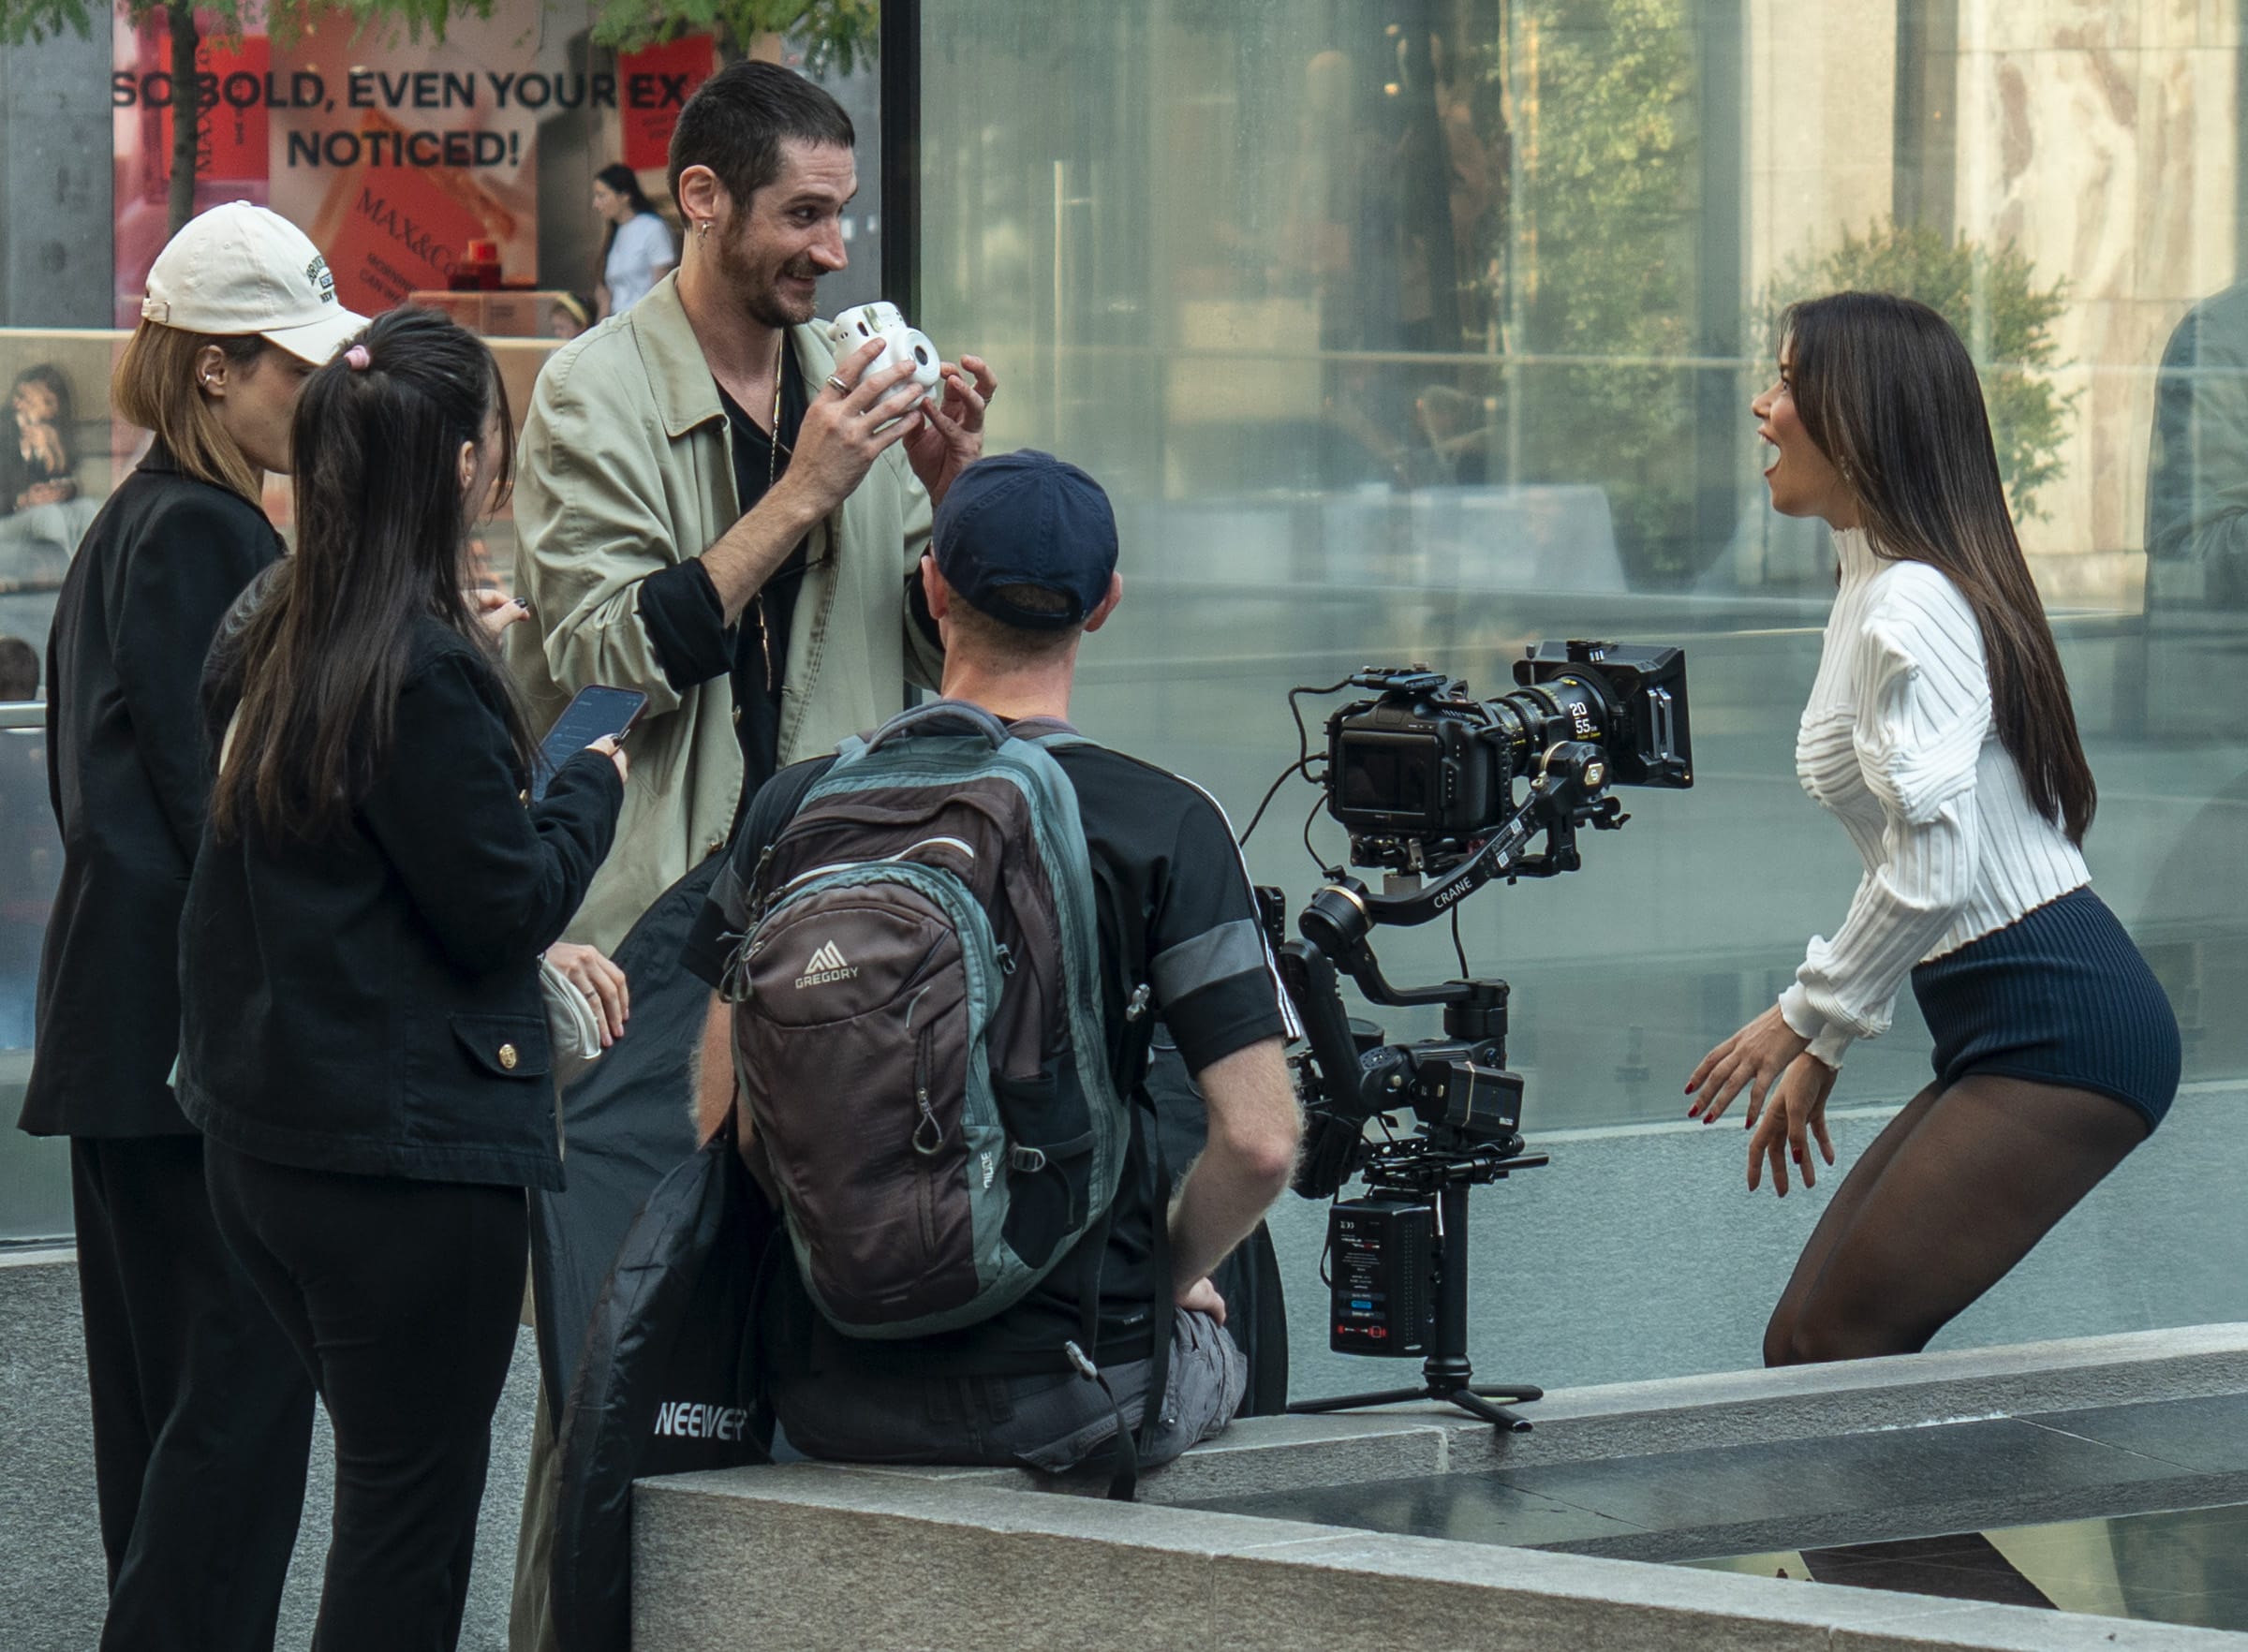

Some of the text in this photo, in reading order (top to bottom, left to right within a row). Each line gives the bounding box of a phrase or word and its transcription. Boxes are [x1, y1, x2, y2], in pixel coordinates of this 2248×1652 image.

[111, 70, 689, 112] SO BOLD, EVEN YOUR EX
[287, 129, 520, 169] NOTICED!
[1568, 701, 1588, 717] 20
[1433, 876, 1472, 908] CRANE
[794, 966, 859, 990] GREGORY
[654, 1401, 748, 1442] NEEWER
